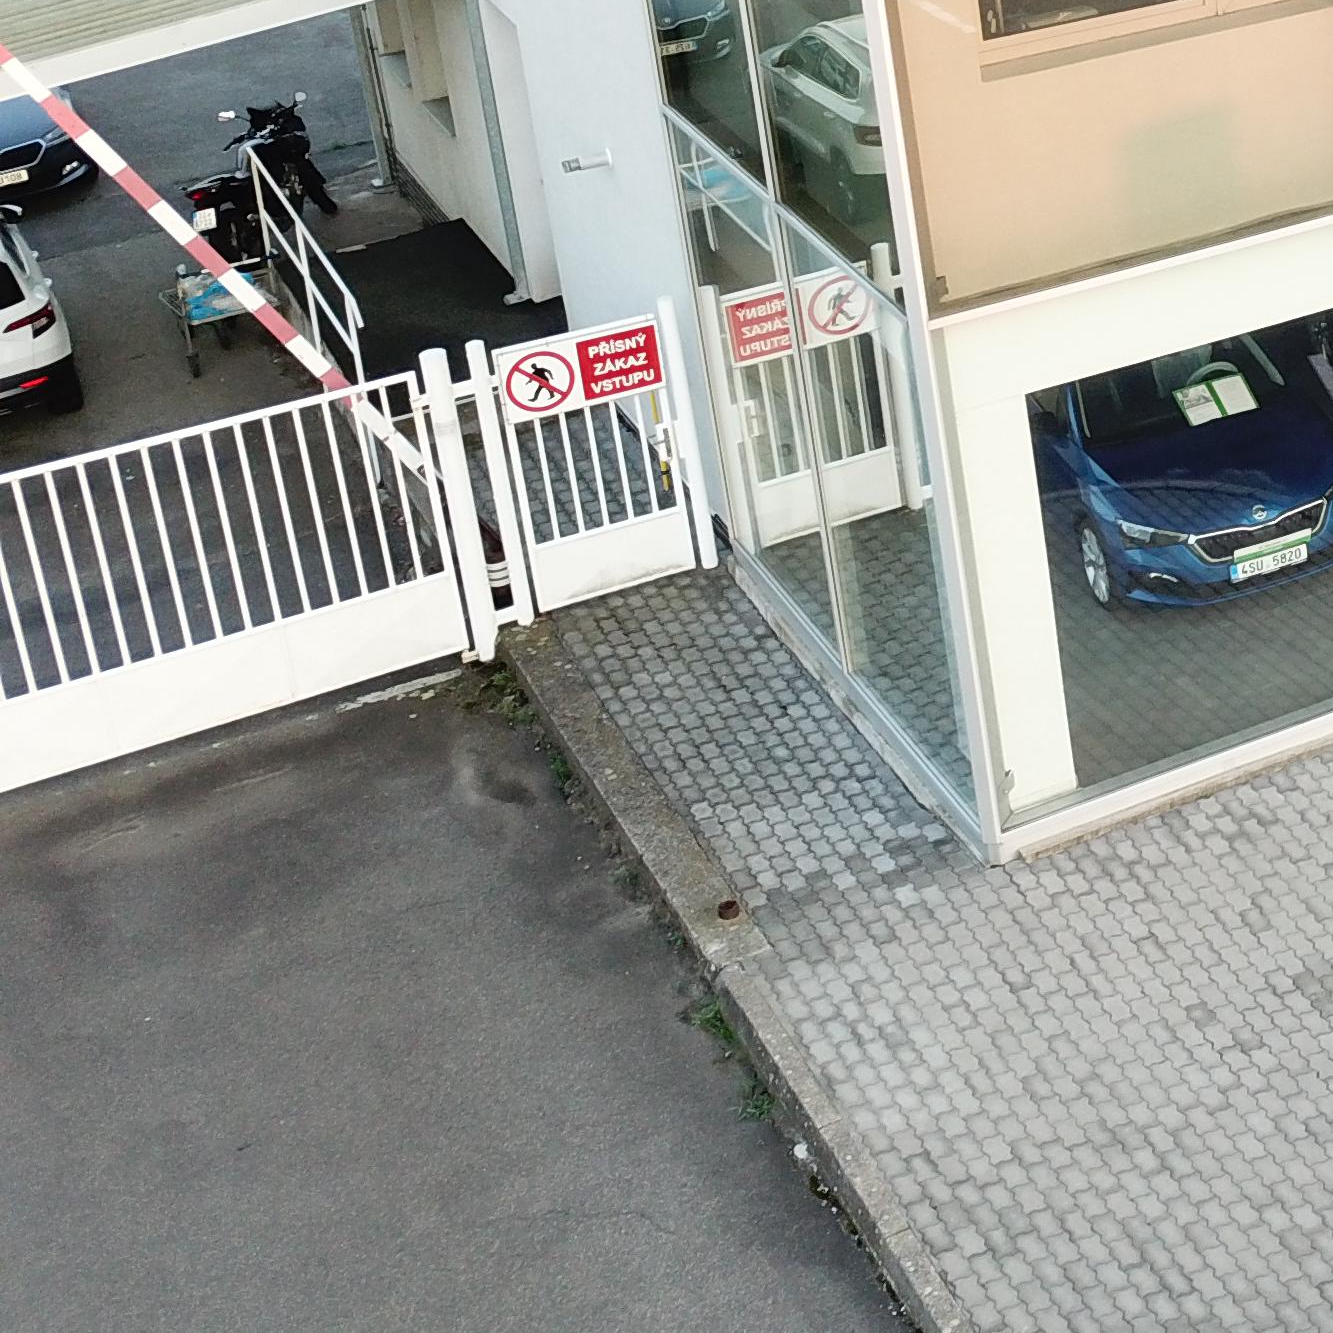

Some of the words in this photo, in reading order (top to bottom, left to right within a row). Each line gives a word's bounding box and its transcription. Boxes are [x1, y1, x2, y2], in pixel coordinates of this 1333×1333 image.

[587, 332, 647, 359] PŘÍSNÝ
[593, 352, 649, 376] ZÁKAZ
[590, 368, 655, 394] VSTUPU
[1241, 559, 1264, 575] 4SU
[1272, 547, 1302, 566] 5820
